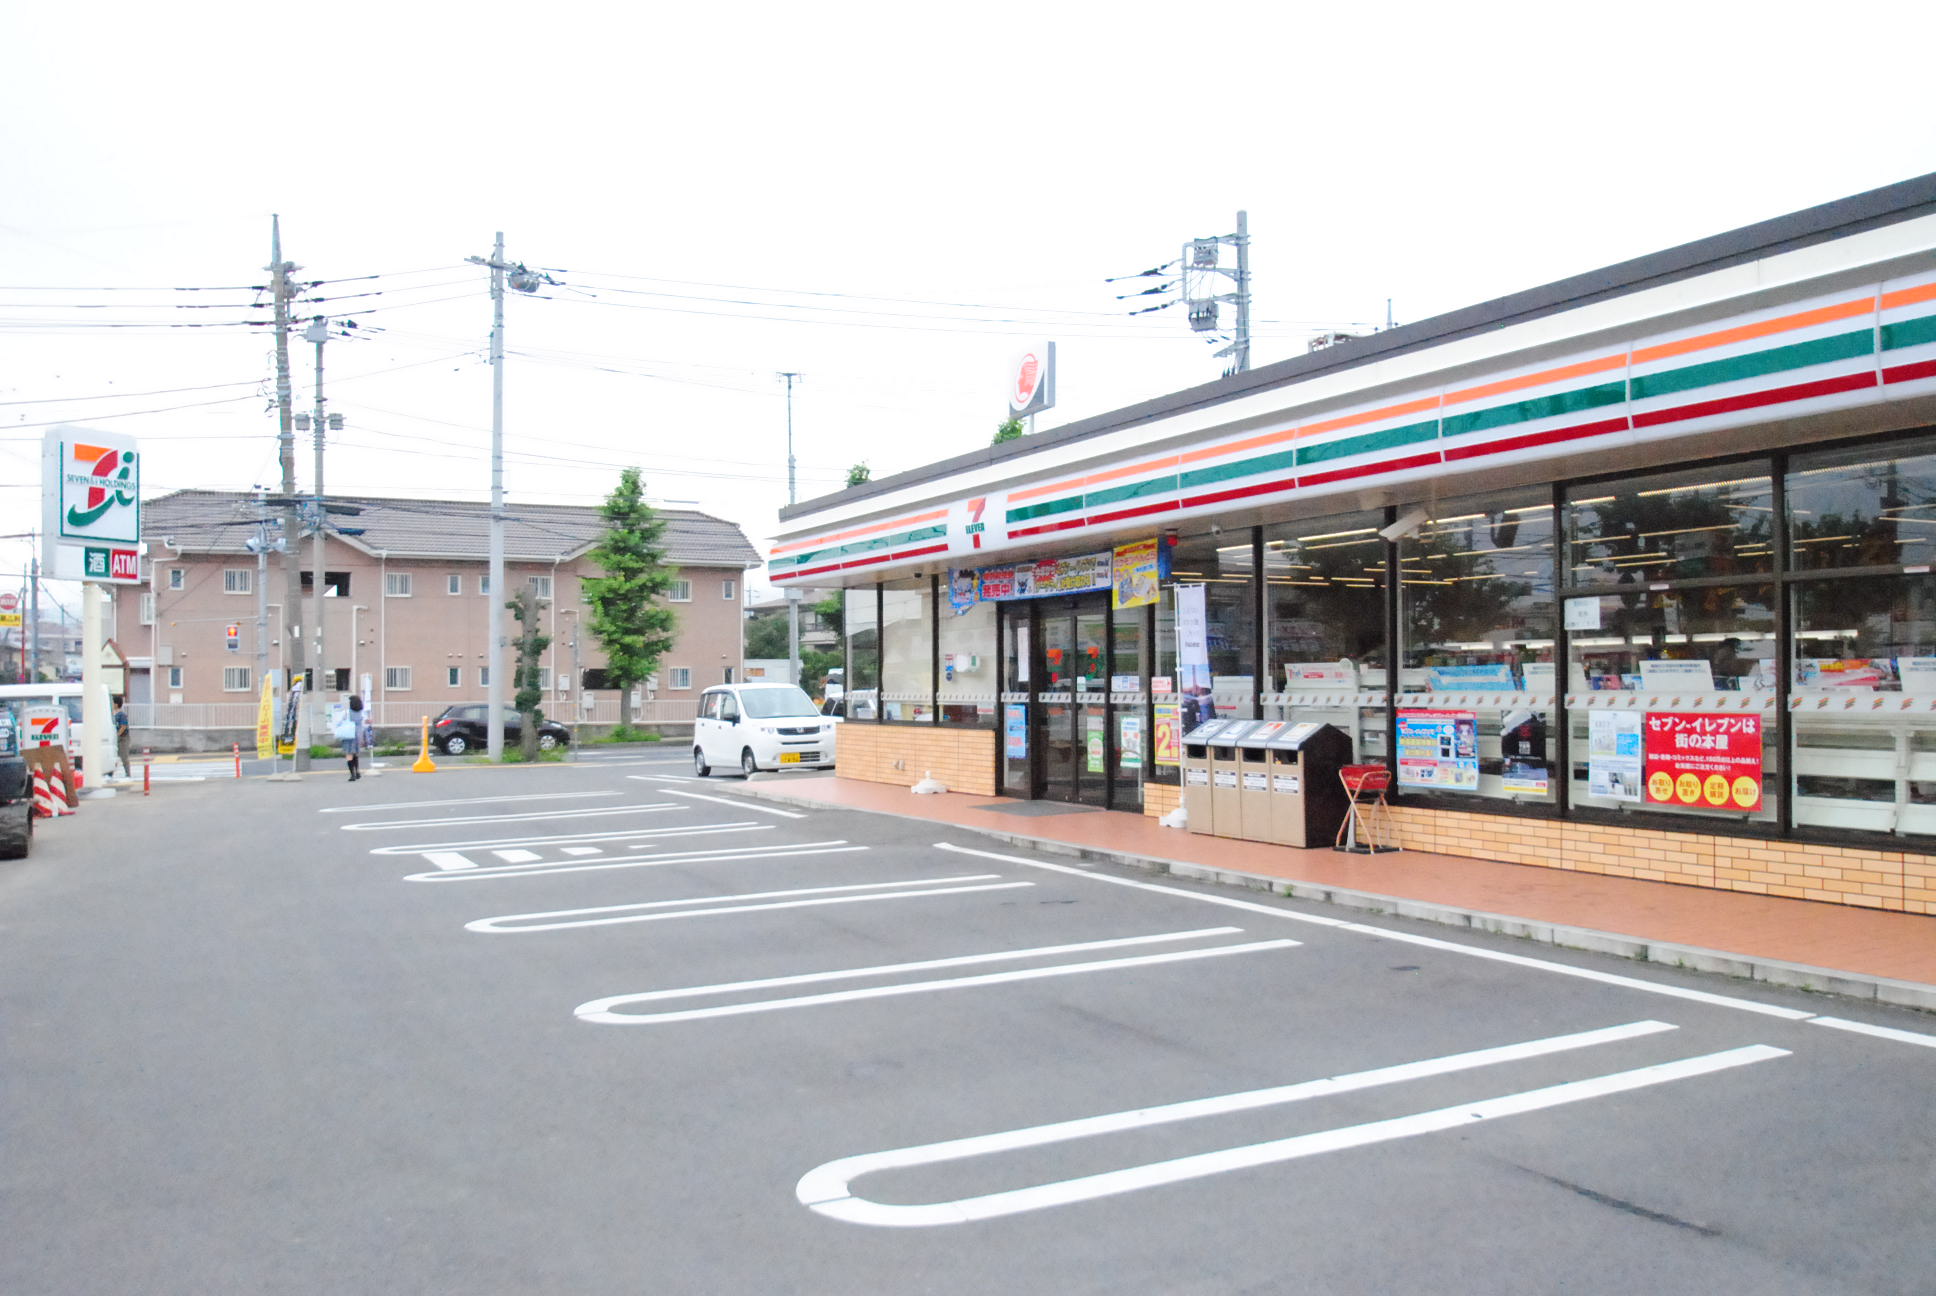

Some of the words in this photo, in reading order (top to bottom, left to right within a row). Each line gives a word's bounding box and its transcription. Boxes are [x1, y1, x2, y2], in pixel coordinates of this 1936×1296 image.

[67, 473, 89, 485] SEVEN
[99, 479, 136, 490] HOLDINGS
[967, 497, 986, 549] 7
[89, 552, 106, 573] 酒
[113, 554, 137, 575] ATM
[1648, 716, 1756, 734] セブン-イレブンは
[1675, 734, 1729, 750] 街の本屋
